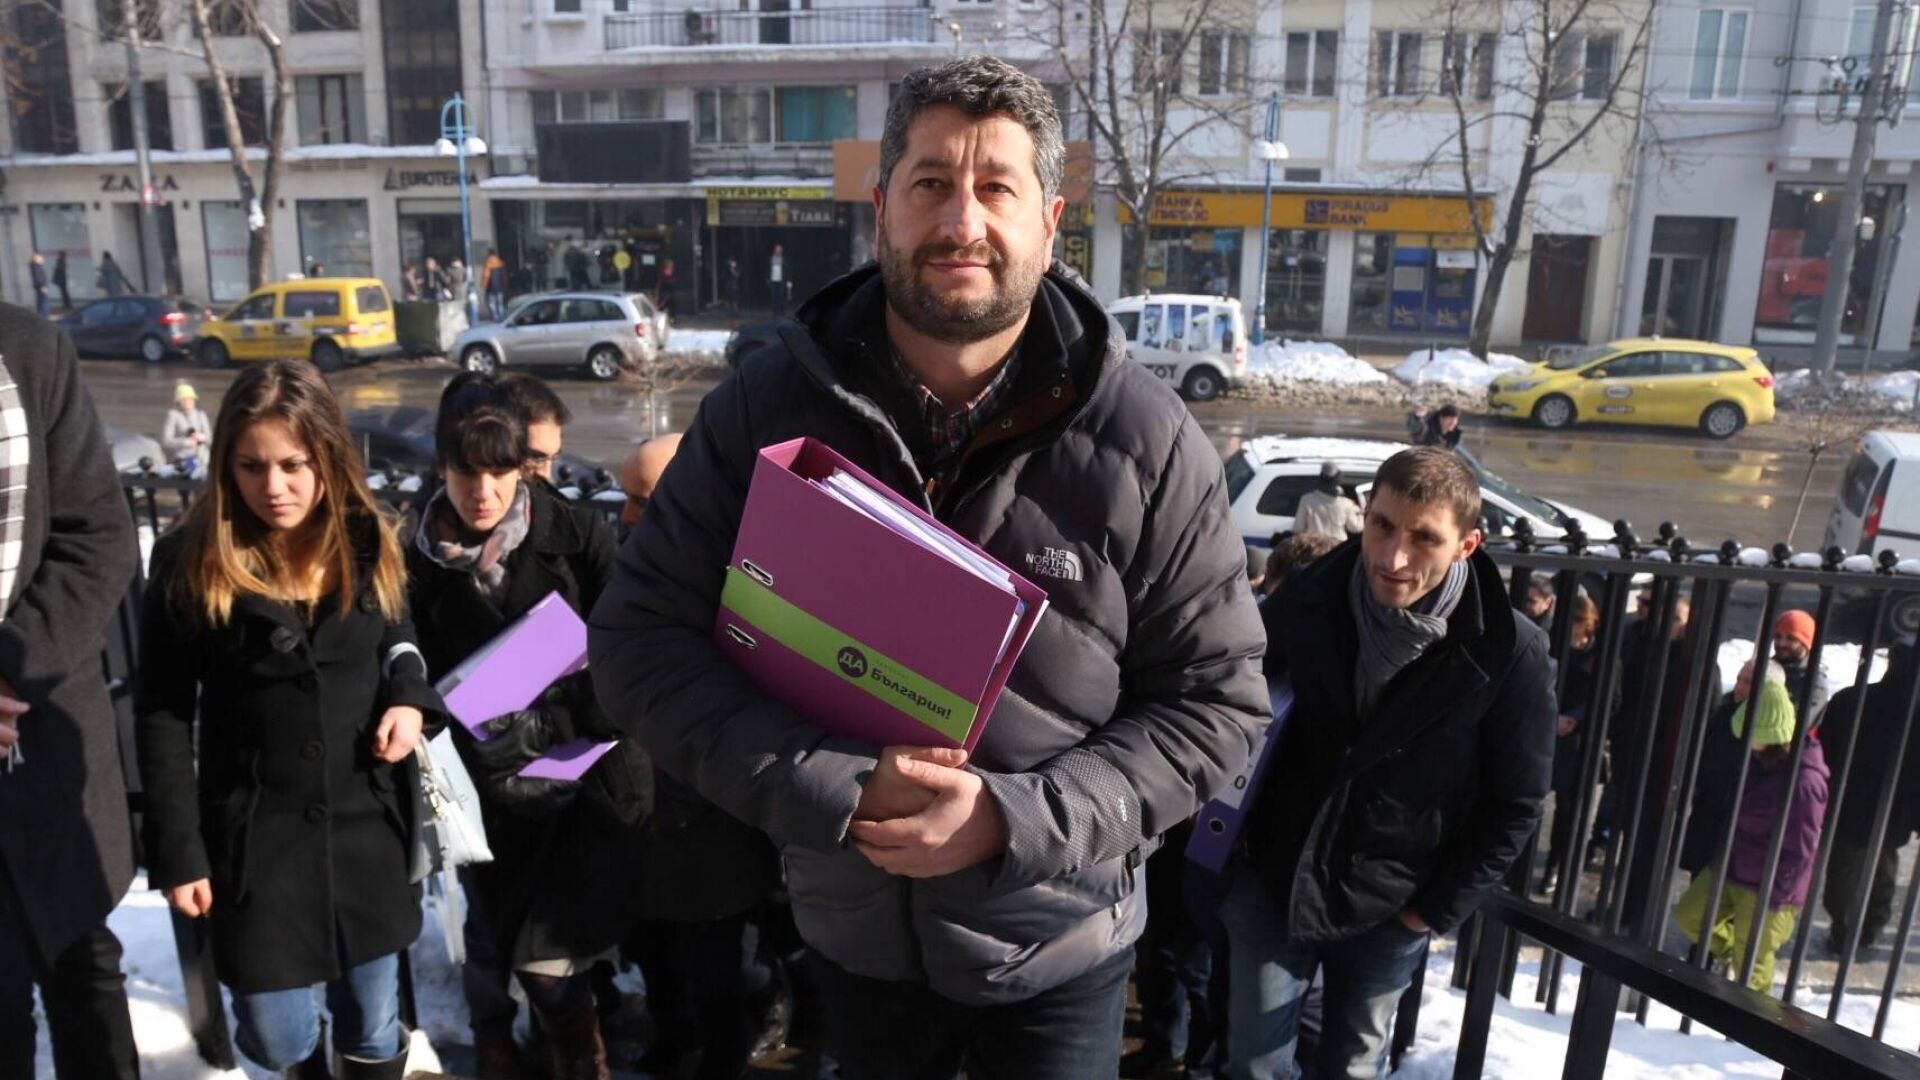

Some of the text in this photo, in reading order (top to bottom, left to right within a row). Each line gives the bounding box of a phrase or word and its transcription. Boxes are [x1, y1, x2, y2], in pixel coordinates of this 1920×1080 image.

[100, 174, 179, 191] ZAA
[398, 169, 478, 187] EUROTERA
[706, 187, 789, 198] НОТАРИУС
[791, 210, 831, 222] TIARA
[1331, 214, 1367, 226] BANK
[1044, 546, 1067, 560] THE
[1025, 552, 1065, 570] NORTH
[1035, 564, 1064, 578] FACE
[839, 650, 865, 674] ДА
[870, 667, 952, 720] България!
